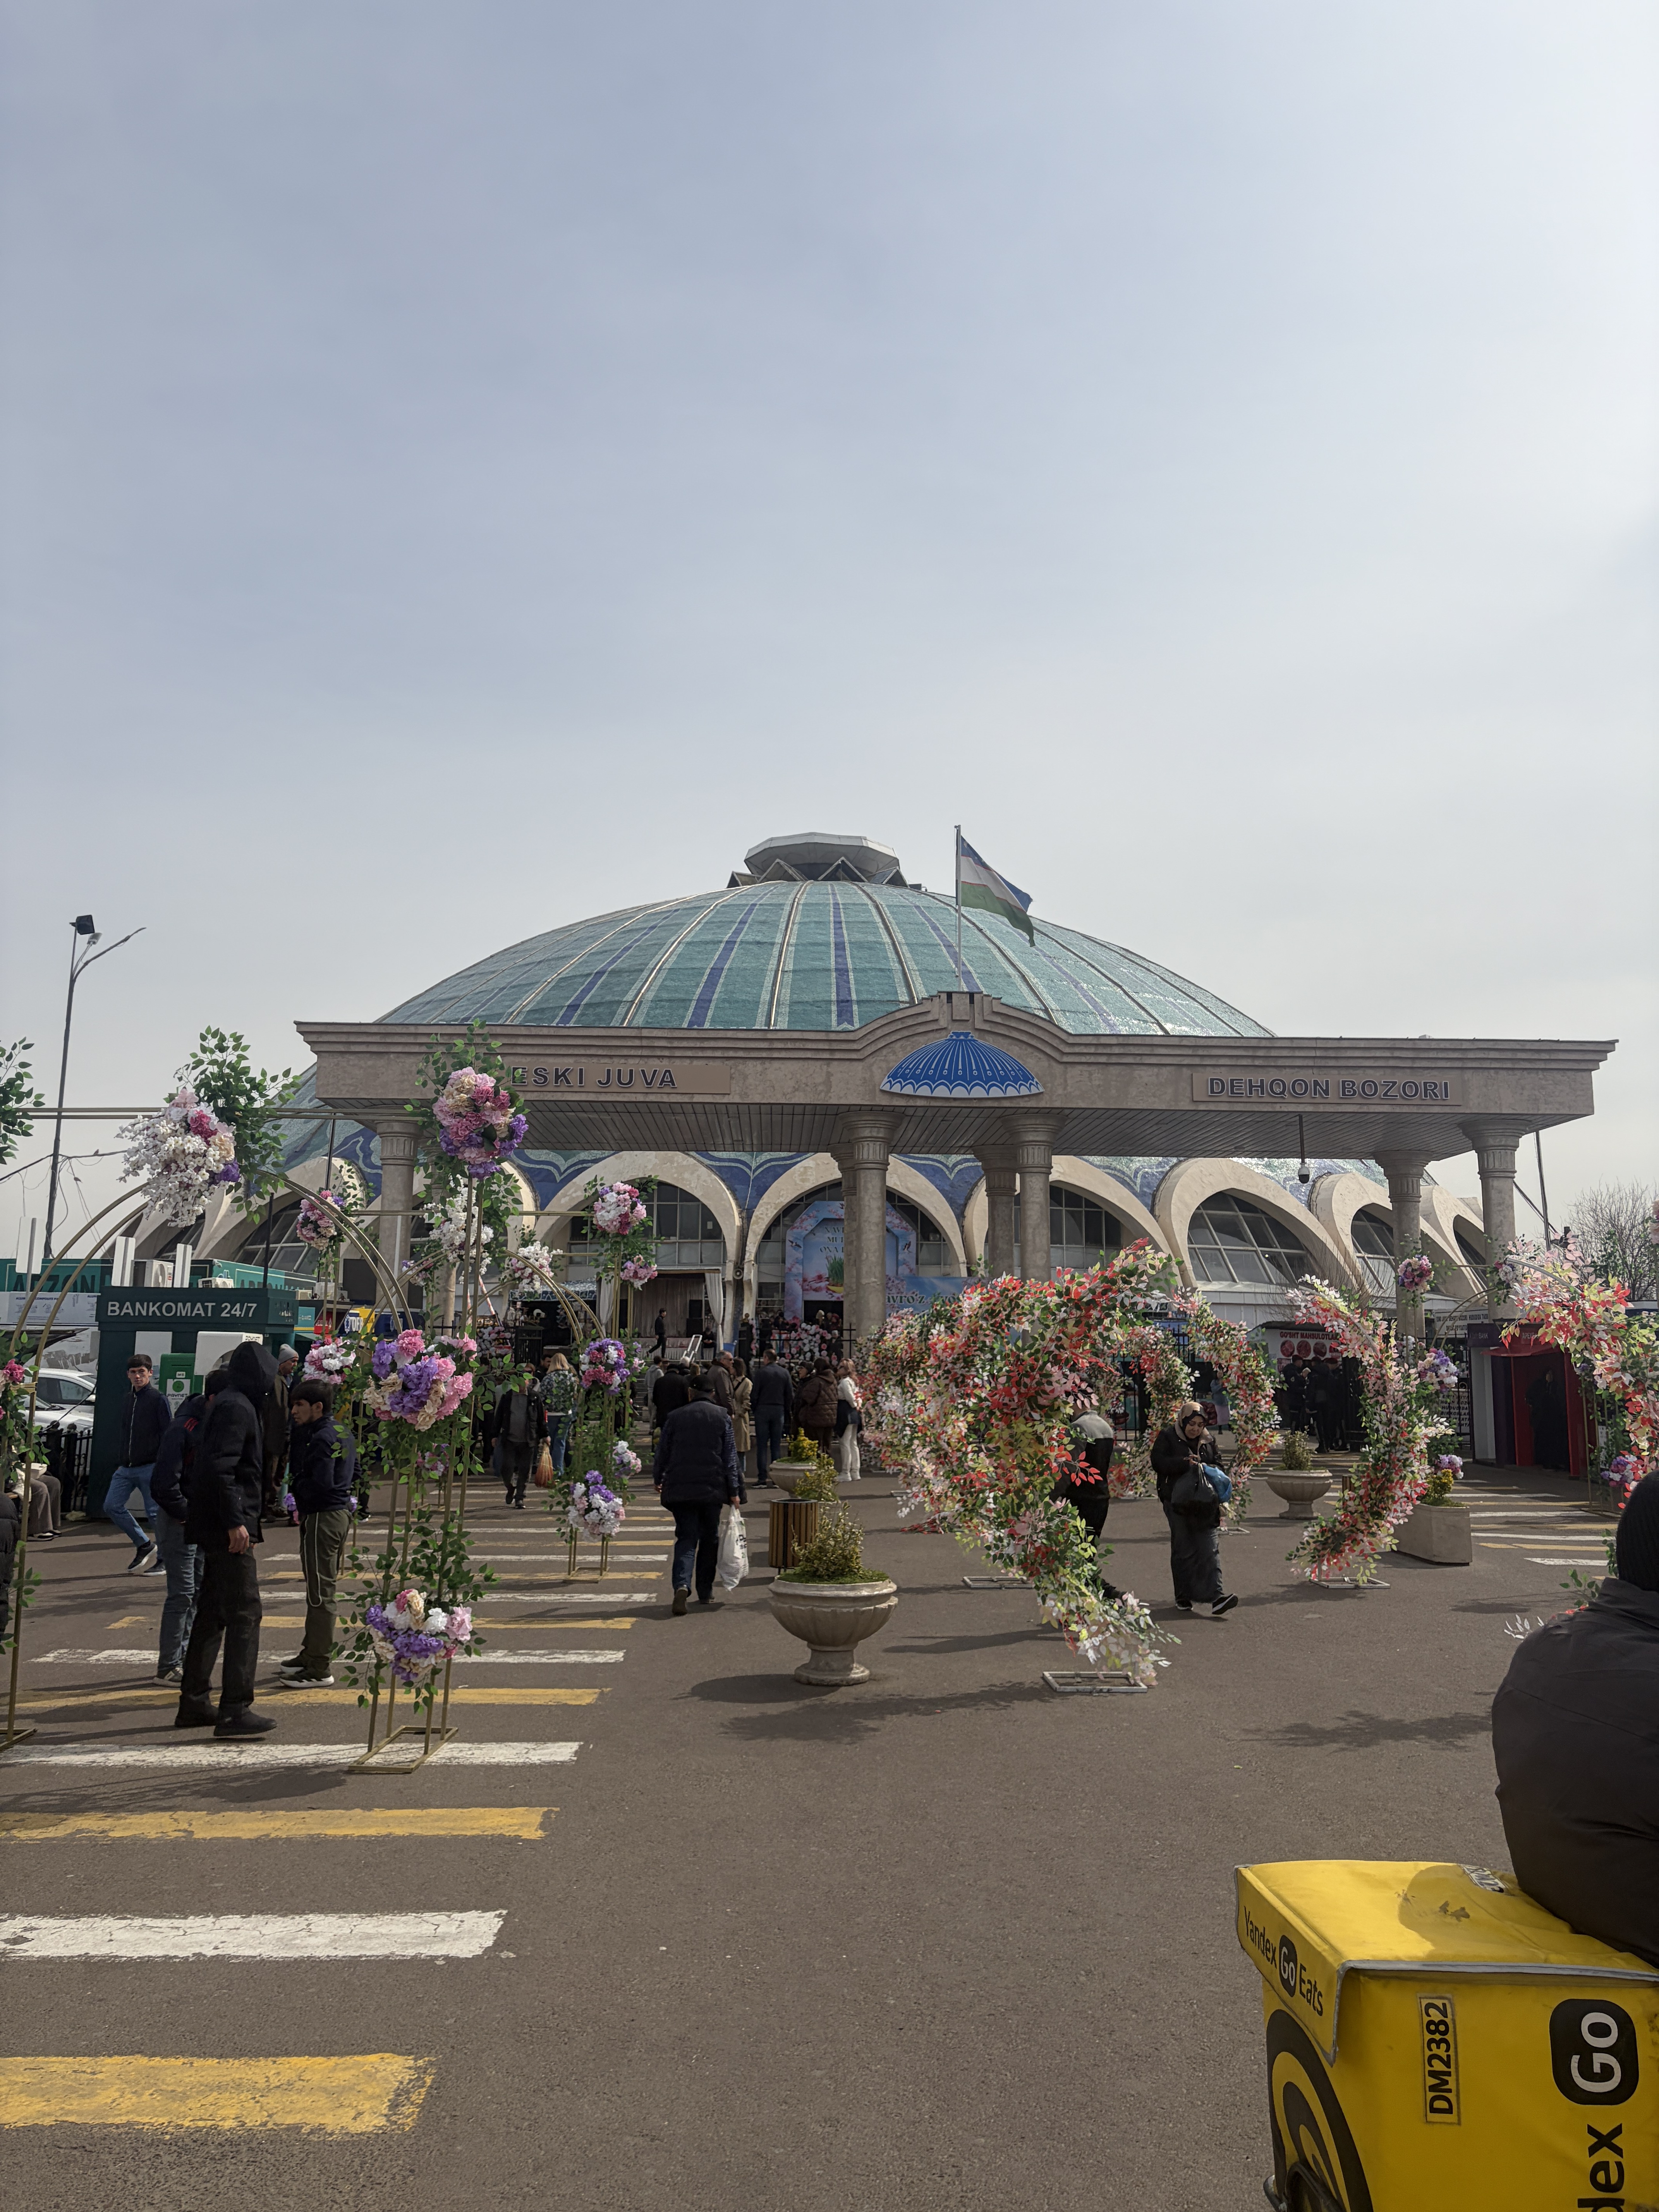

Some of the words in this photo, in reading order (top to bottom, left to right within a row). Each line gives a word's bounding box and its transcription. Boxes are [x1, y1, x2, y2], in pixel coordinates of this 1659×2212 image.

[511, 1066, 584, 1087] ESKI
[597, 1068, 677, 1088] JUVA
[1208, 1077, 1331, 1099] DEHQON
[1340, 1079, 1450, 1100] BOZORI
[108, 1301, 215, 1317] BANKOMAT
[220, 1302, 257, 1317] 24/7
[1244, 1905, 1277, 1969] Yandex
[1281, 1946, 1295, 1987] Go
[1299, 1963, 1323, 2016] Eats
[1424, 2002, 1453, 2115] DM2382
[1571, 2012, 1621, 2093] Go
